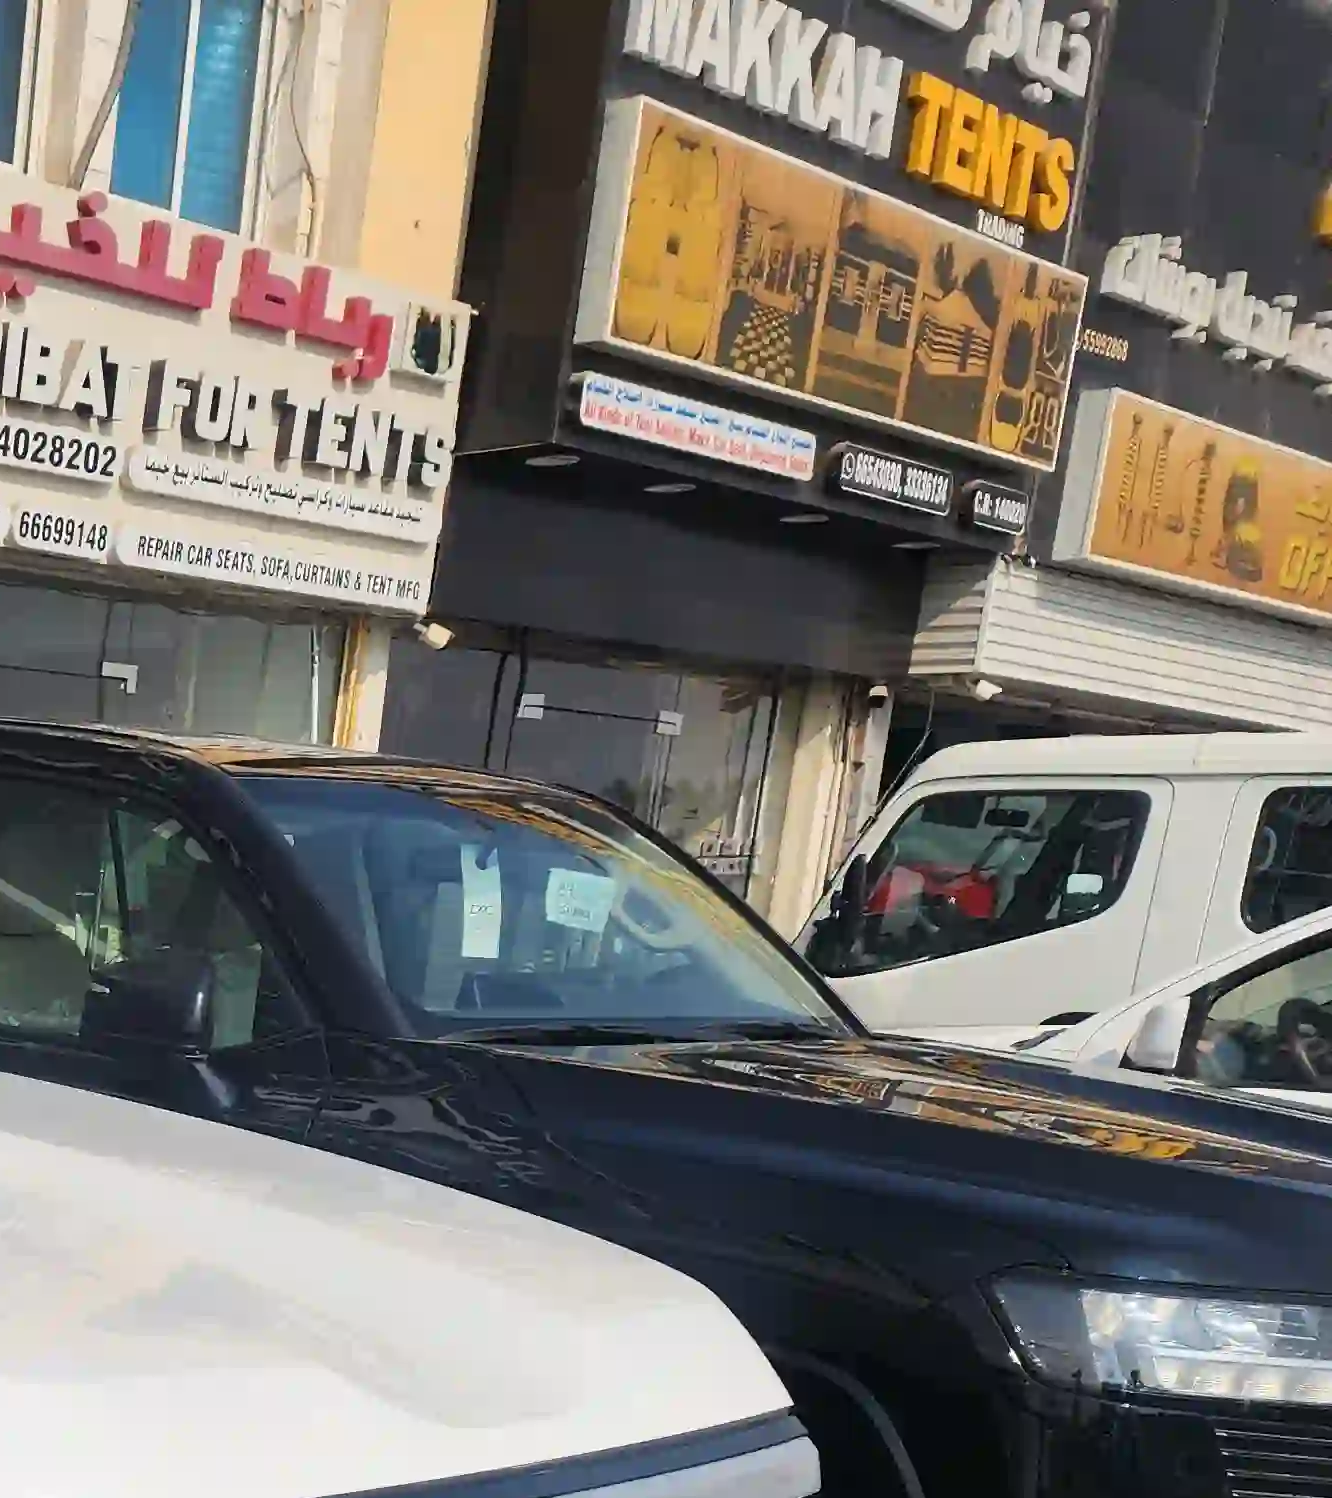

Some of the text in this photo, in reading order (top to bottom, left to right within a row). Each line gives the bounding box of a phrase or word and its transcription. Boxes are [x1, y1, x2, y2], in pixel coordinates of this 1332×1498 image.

[622, 0, 1074, 232] MAKKAH TENTS
[977, 208, 1025, 249] TRADING
[231, 247, 394, 381] رباط
[144, 359, 261, 450] FOR
[274, 389, 454, 487] TENTS
[18, 511, 108, 552] 66699148
[137, 535, 184, 563] REPAIR
[187, 545, 212, 567] CAR
[215, 548, 256, 577] SEATS,
[354, 575, 362, 591] &
[366, 574, 393, 597] TENT
